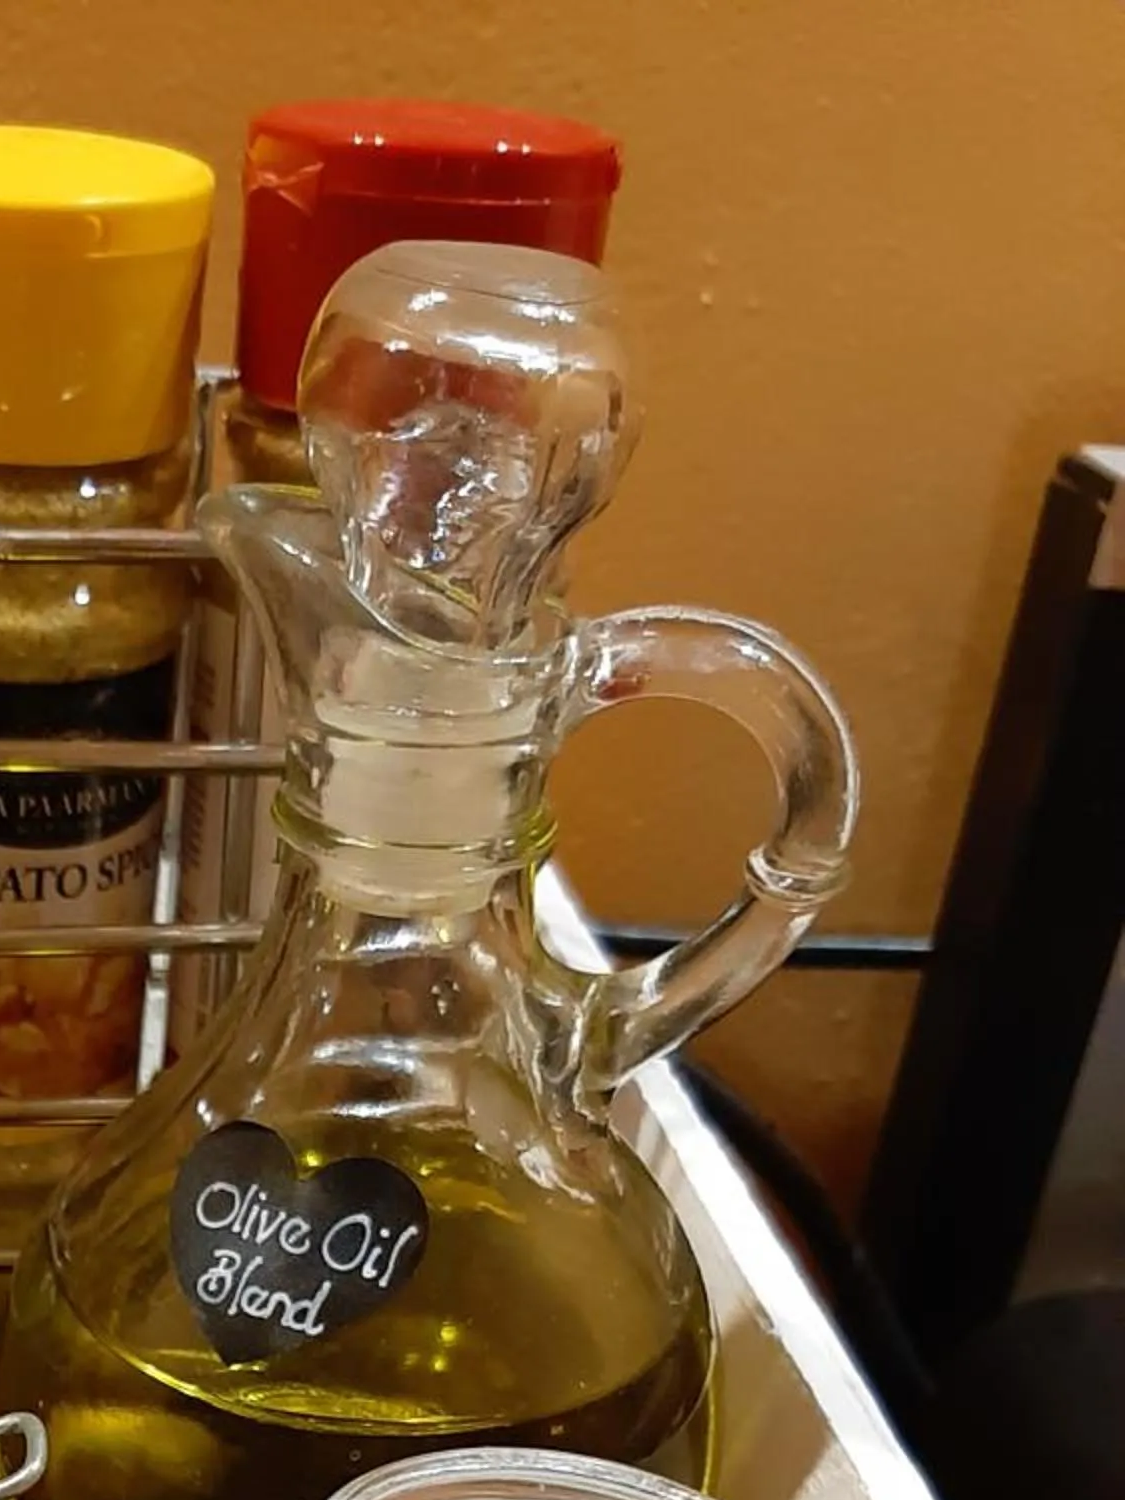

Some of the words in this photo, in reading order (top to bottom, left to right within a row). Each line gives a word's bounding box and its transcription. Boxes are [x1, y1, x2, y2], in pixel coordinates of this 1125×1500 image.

[195, 1180, 312, 1254] Olive
[321, 1212, 420, 1288] Oil
[196, 1249, 332, 1336] Blend
